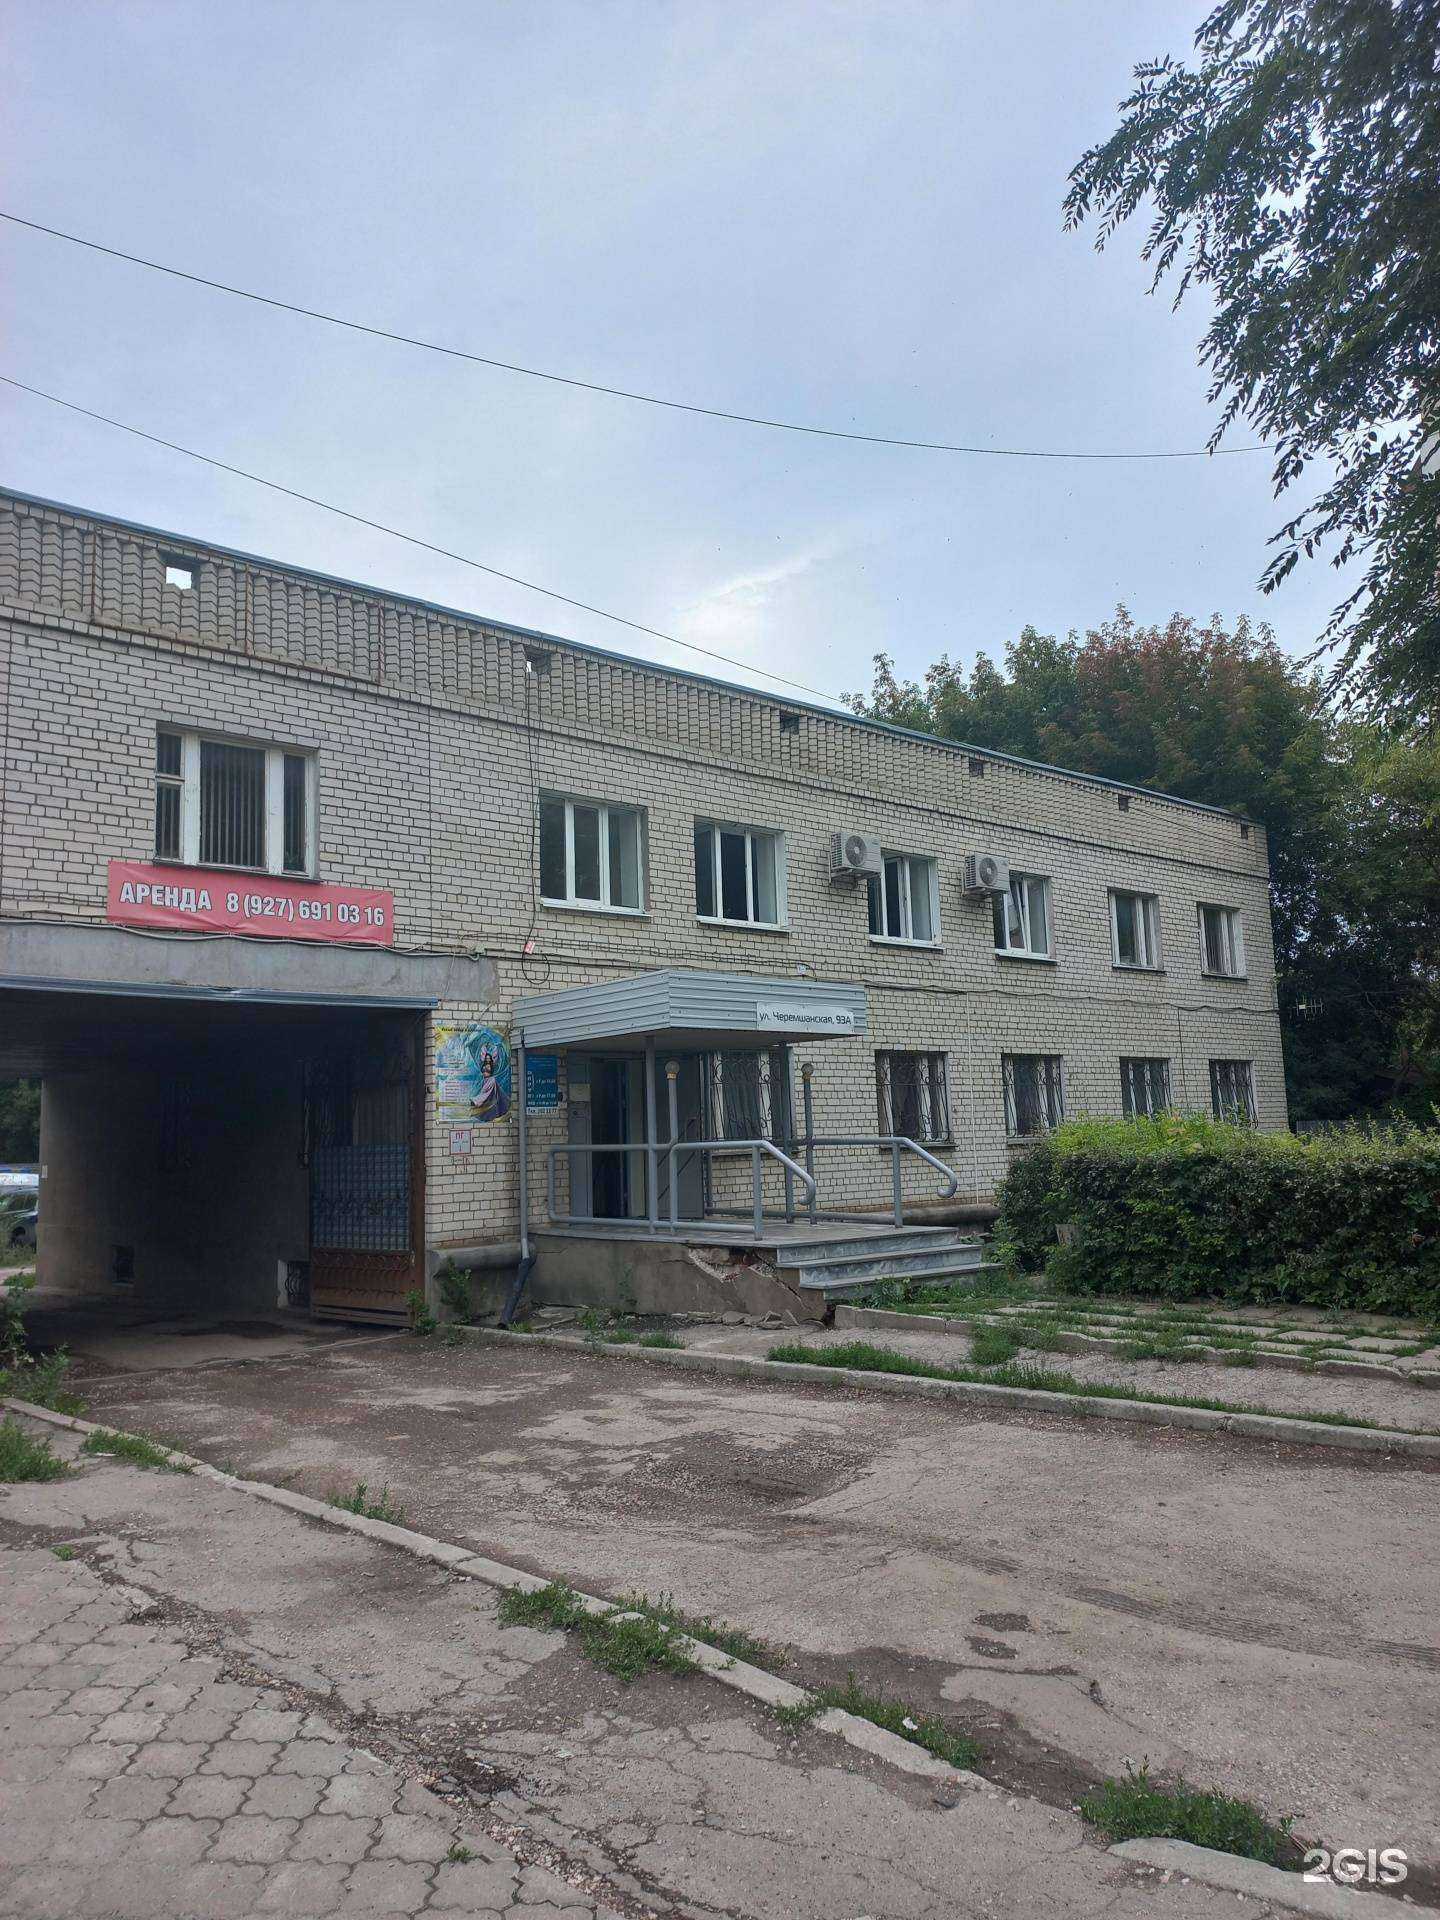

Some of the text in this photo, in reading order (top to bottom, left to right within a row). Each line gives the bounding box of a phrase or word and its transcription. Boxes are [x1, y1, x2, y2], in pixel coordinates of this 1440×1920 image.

[119, 881, 385, 926] АРЕНДА 8 (927) 691 03 16
[759, 1011, 852, 1025] ул. Черемшанская, 93А
